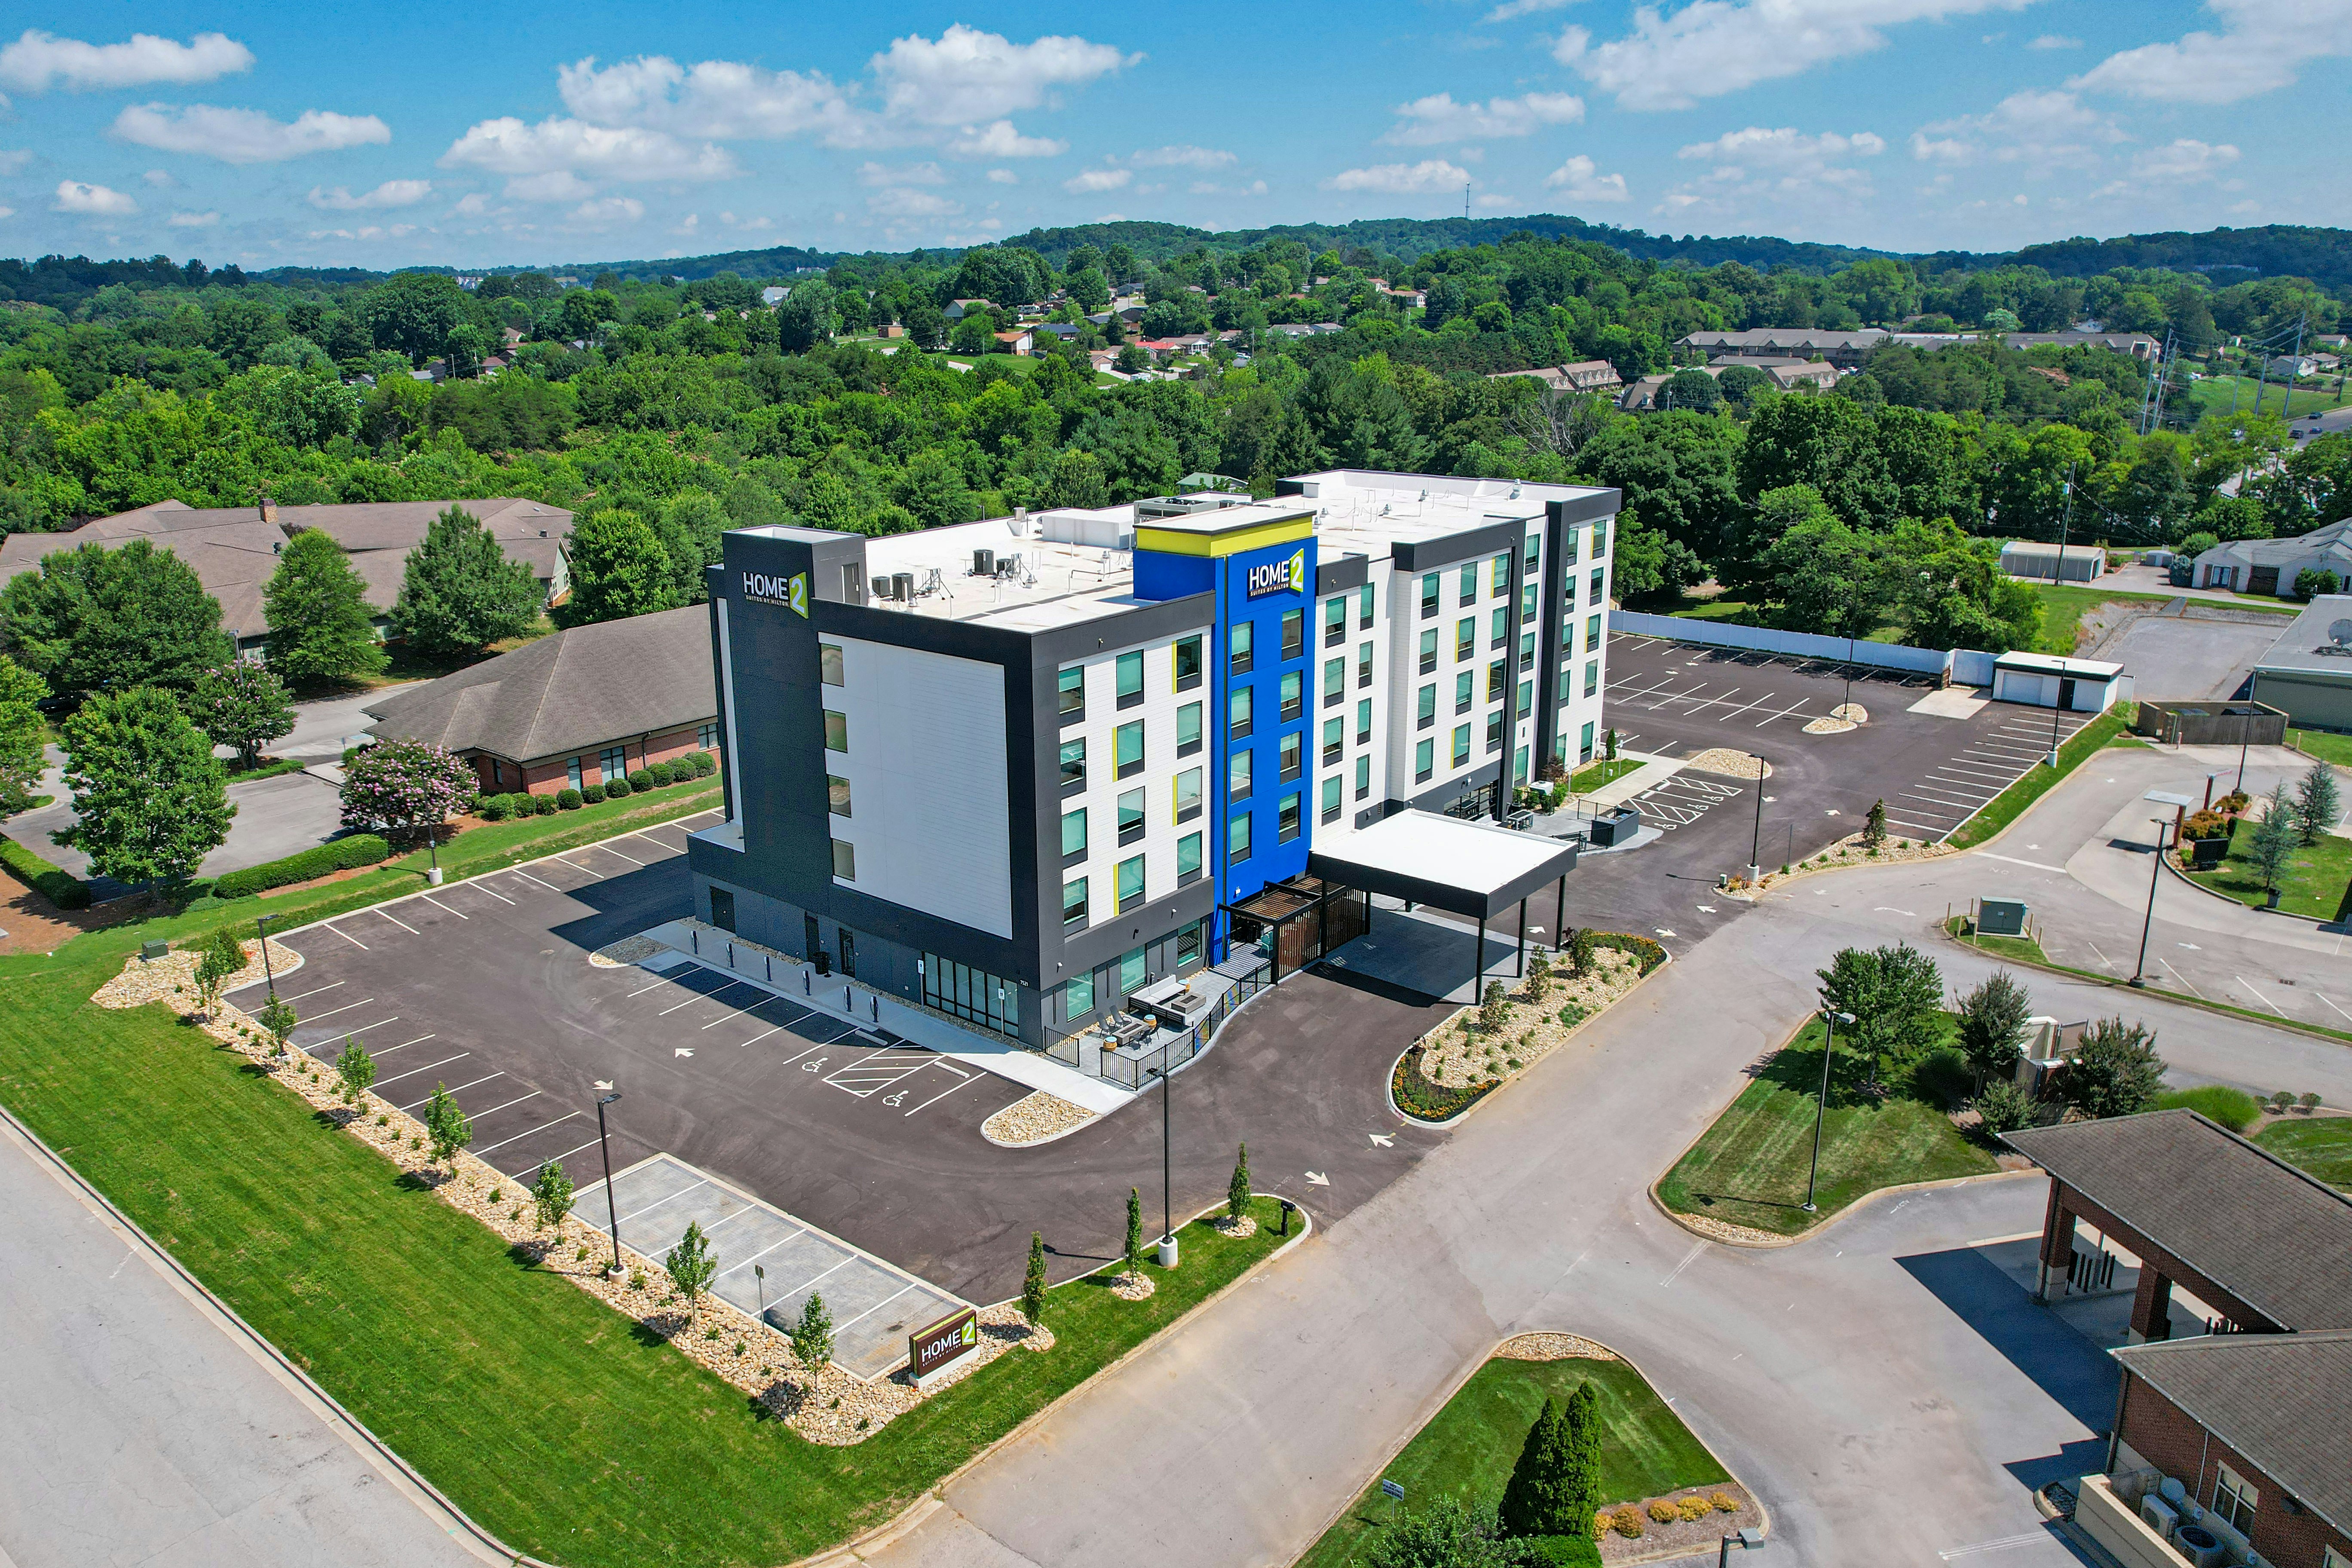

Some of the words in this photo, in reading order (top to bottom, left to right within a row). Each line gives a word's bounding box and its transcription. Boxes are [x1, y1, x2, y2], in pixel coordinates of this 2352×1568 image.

[1249, 560, 1290, 591] HOME
[1291, 556, 1303, 588] 2
[743, 572, 789, 600] HOME
[791, 577, 805, 614] 2
[1250, 588, 1266, 597] SUITES
[921, 1328, 961, 1363] HOME
[963, 1321, 974, 1343] 2
[922, 1356, 938, 1367] SUITES
[946, 1343, 962, 1354] HILTON
[1383, 1484, 1403, 1495] PARKING
